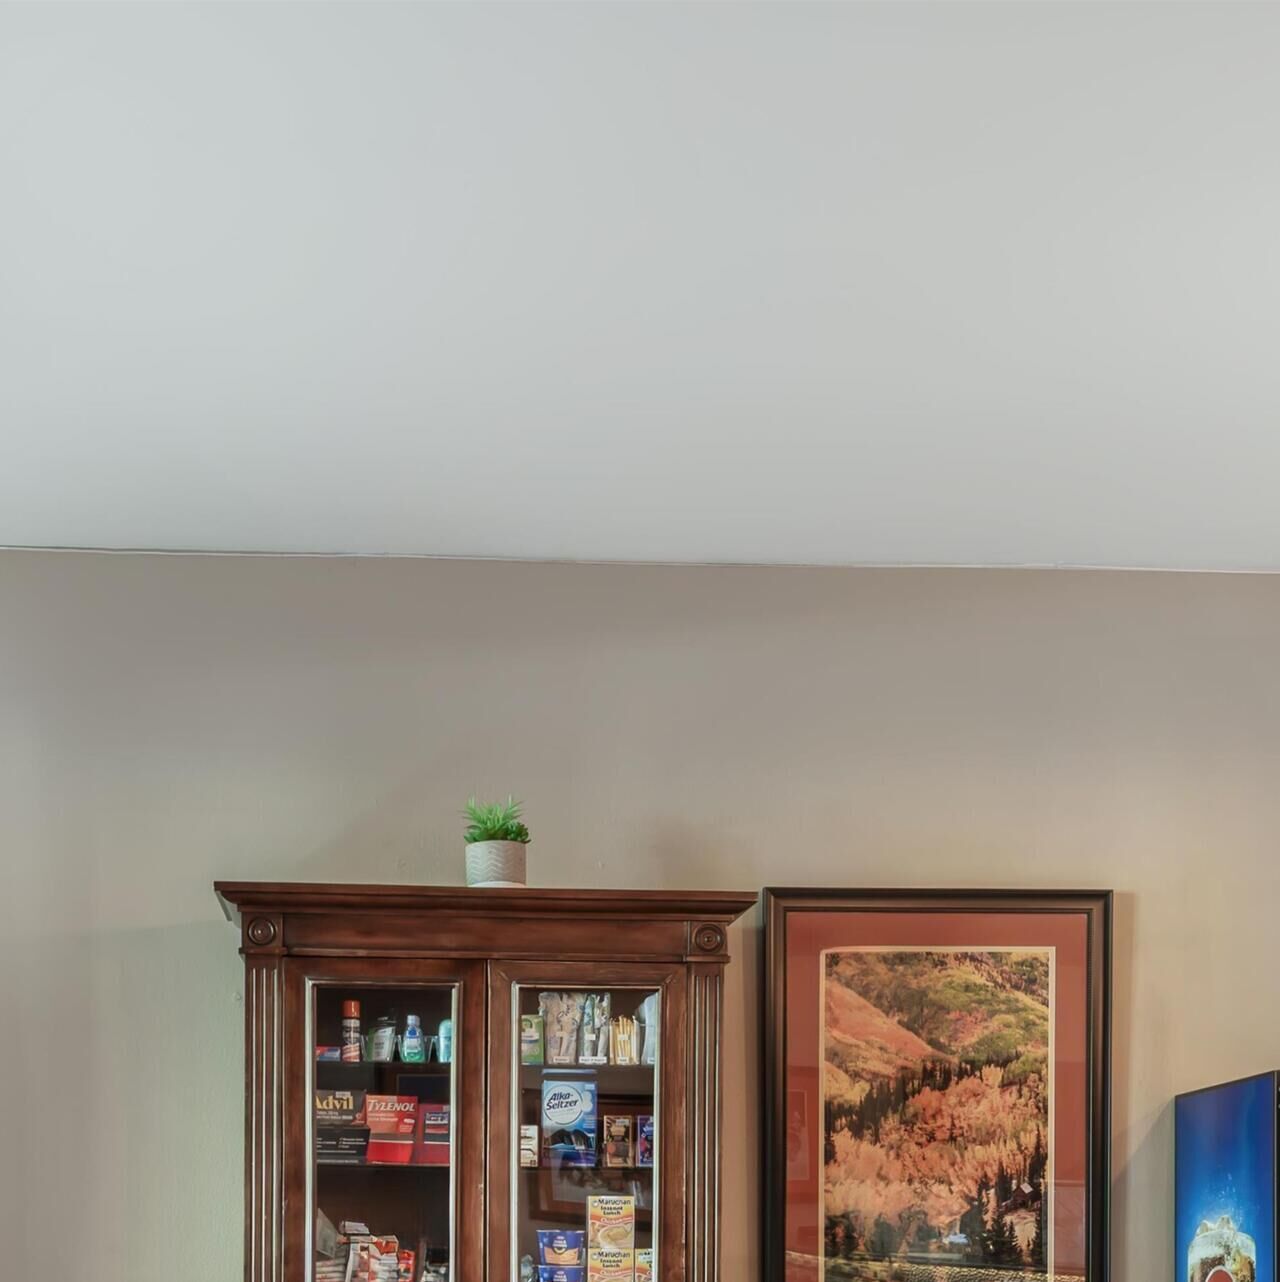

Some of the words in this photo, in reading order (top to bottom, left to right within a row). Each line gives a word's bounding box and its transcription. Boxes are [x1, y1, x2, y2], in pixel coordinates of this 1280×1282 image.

[367, 1099, 415, 1113] TYLENOL
[546, 1099, 580, 1111] Seltzer
[598, 1198, 632, 1206] Maruchan
[597, 1250, 631, 1258] Maruchan
